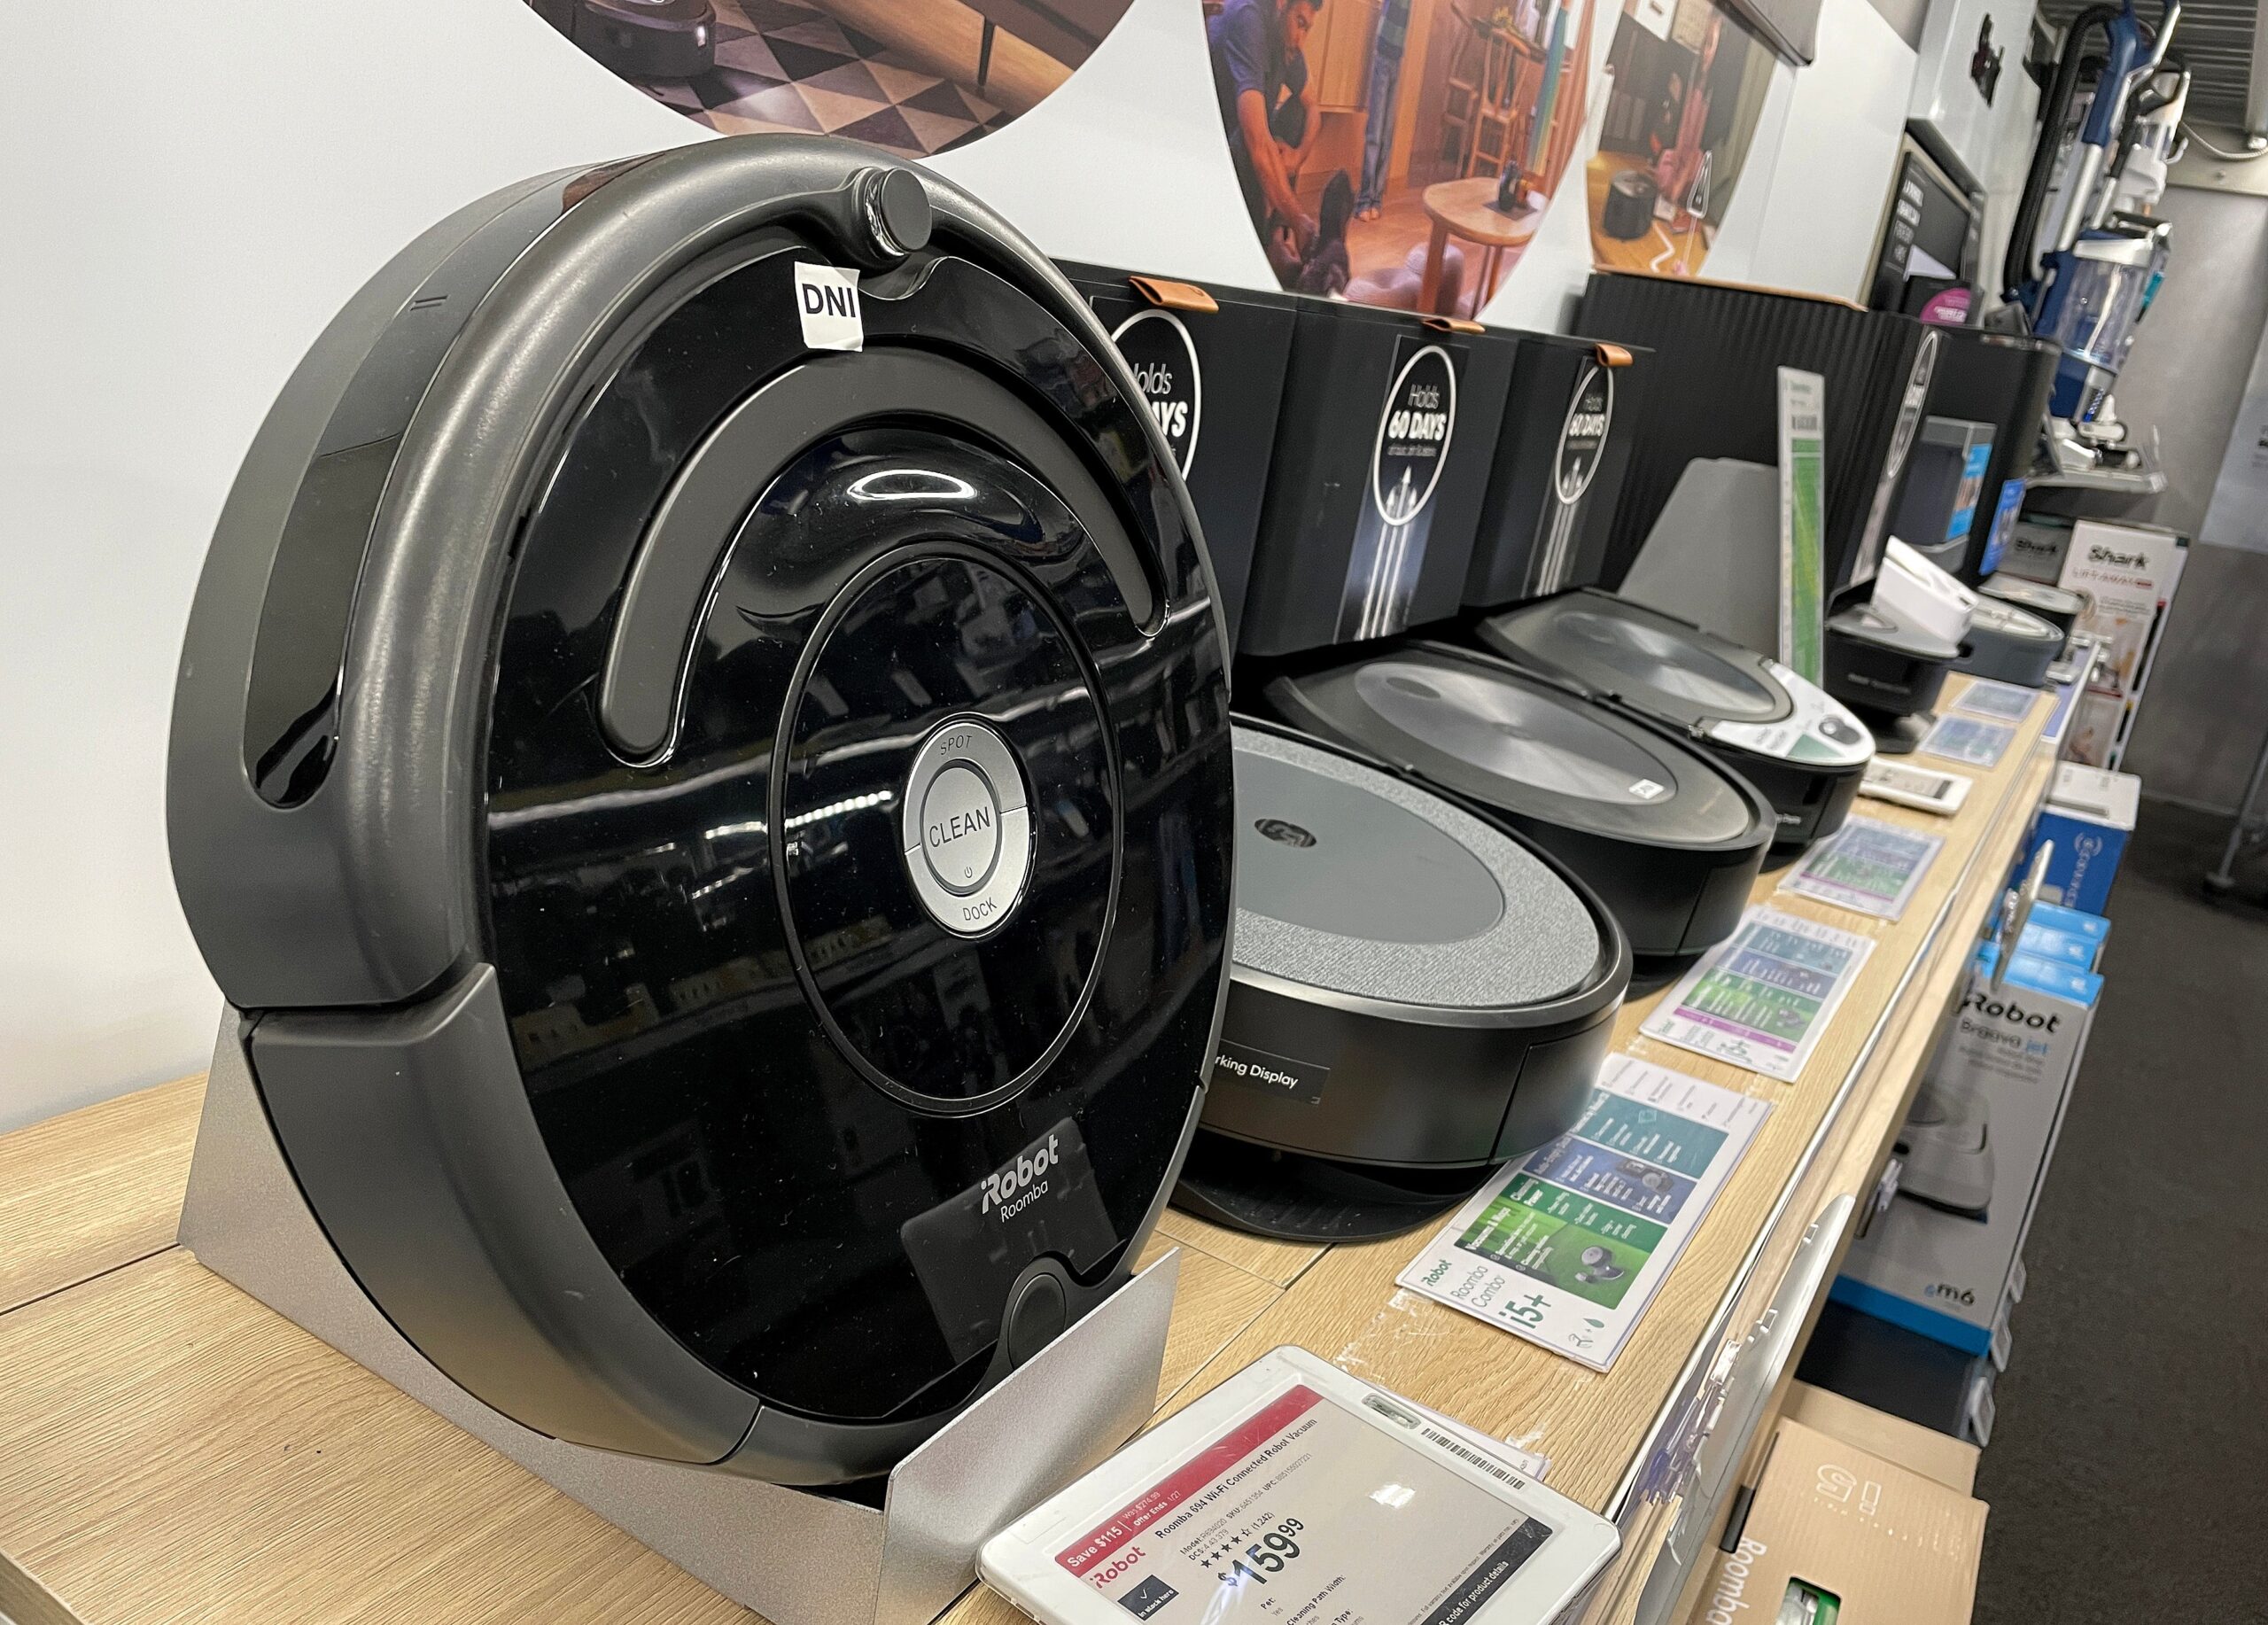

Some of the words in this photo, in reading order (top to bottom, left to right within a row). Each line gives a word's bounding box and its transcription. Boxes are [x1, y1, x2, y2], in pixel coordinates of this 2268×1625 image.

[802, 283, 856, 317] DNI
[1388, 409, 1411, 439] 60
[1409, 411, 1448, 441] DAYS
[2089, 544, 2150, 571] Shark
[940, 735, 973, 756] SPOT
[928, 806, 991, 848] CLEAN
[962, 897, 998, 921] DOCK
[1215, 1054, 1247, 1076] rking
[1249, 1064, 1299, 1090] Display
[981, 1134, 1059, 1215] iRobot
[1000, 1180, 1049, 1223] Roomba
[1450, 1264, 1488, 1300] Roomba
[1472, 1274, 1505, 1308] Combo
[1498, 1293, 1551, 1329] i5+
[1154, 1511, 1193, 1539] Roomba
[1190, 1499, 1208, 1513] 694
[1204, 1483, 1228, 1503] Wi-Fi
[1226, 1454, 1269, 1486] Connected
[1264, 1438, 1291, 1457] Robot
[1286, 1418, 1317, 1441] Vacuum
[1133, 1512, 1152, 1527] Offer
[1151, 1500, 1169, 1514] Ends
[1067, 1546, 1099, 1567] Save
[1094, 1526, 1122, 1548] $115
[1090, 1546, 1146, 1589] iRobot
[1705, 1536, 1767, 1625] Roomba
[1286, 1601, 1317, 1625] Cleaning
[1313, 1590, 1329, 1606] Path
[1448, 1604, 1464, 1623] code
[1460, 1598, 1472, 1610] for
[1468, 1576, 1492, 1602] product
[1488, 1560, 1510, 1581] details
